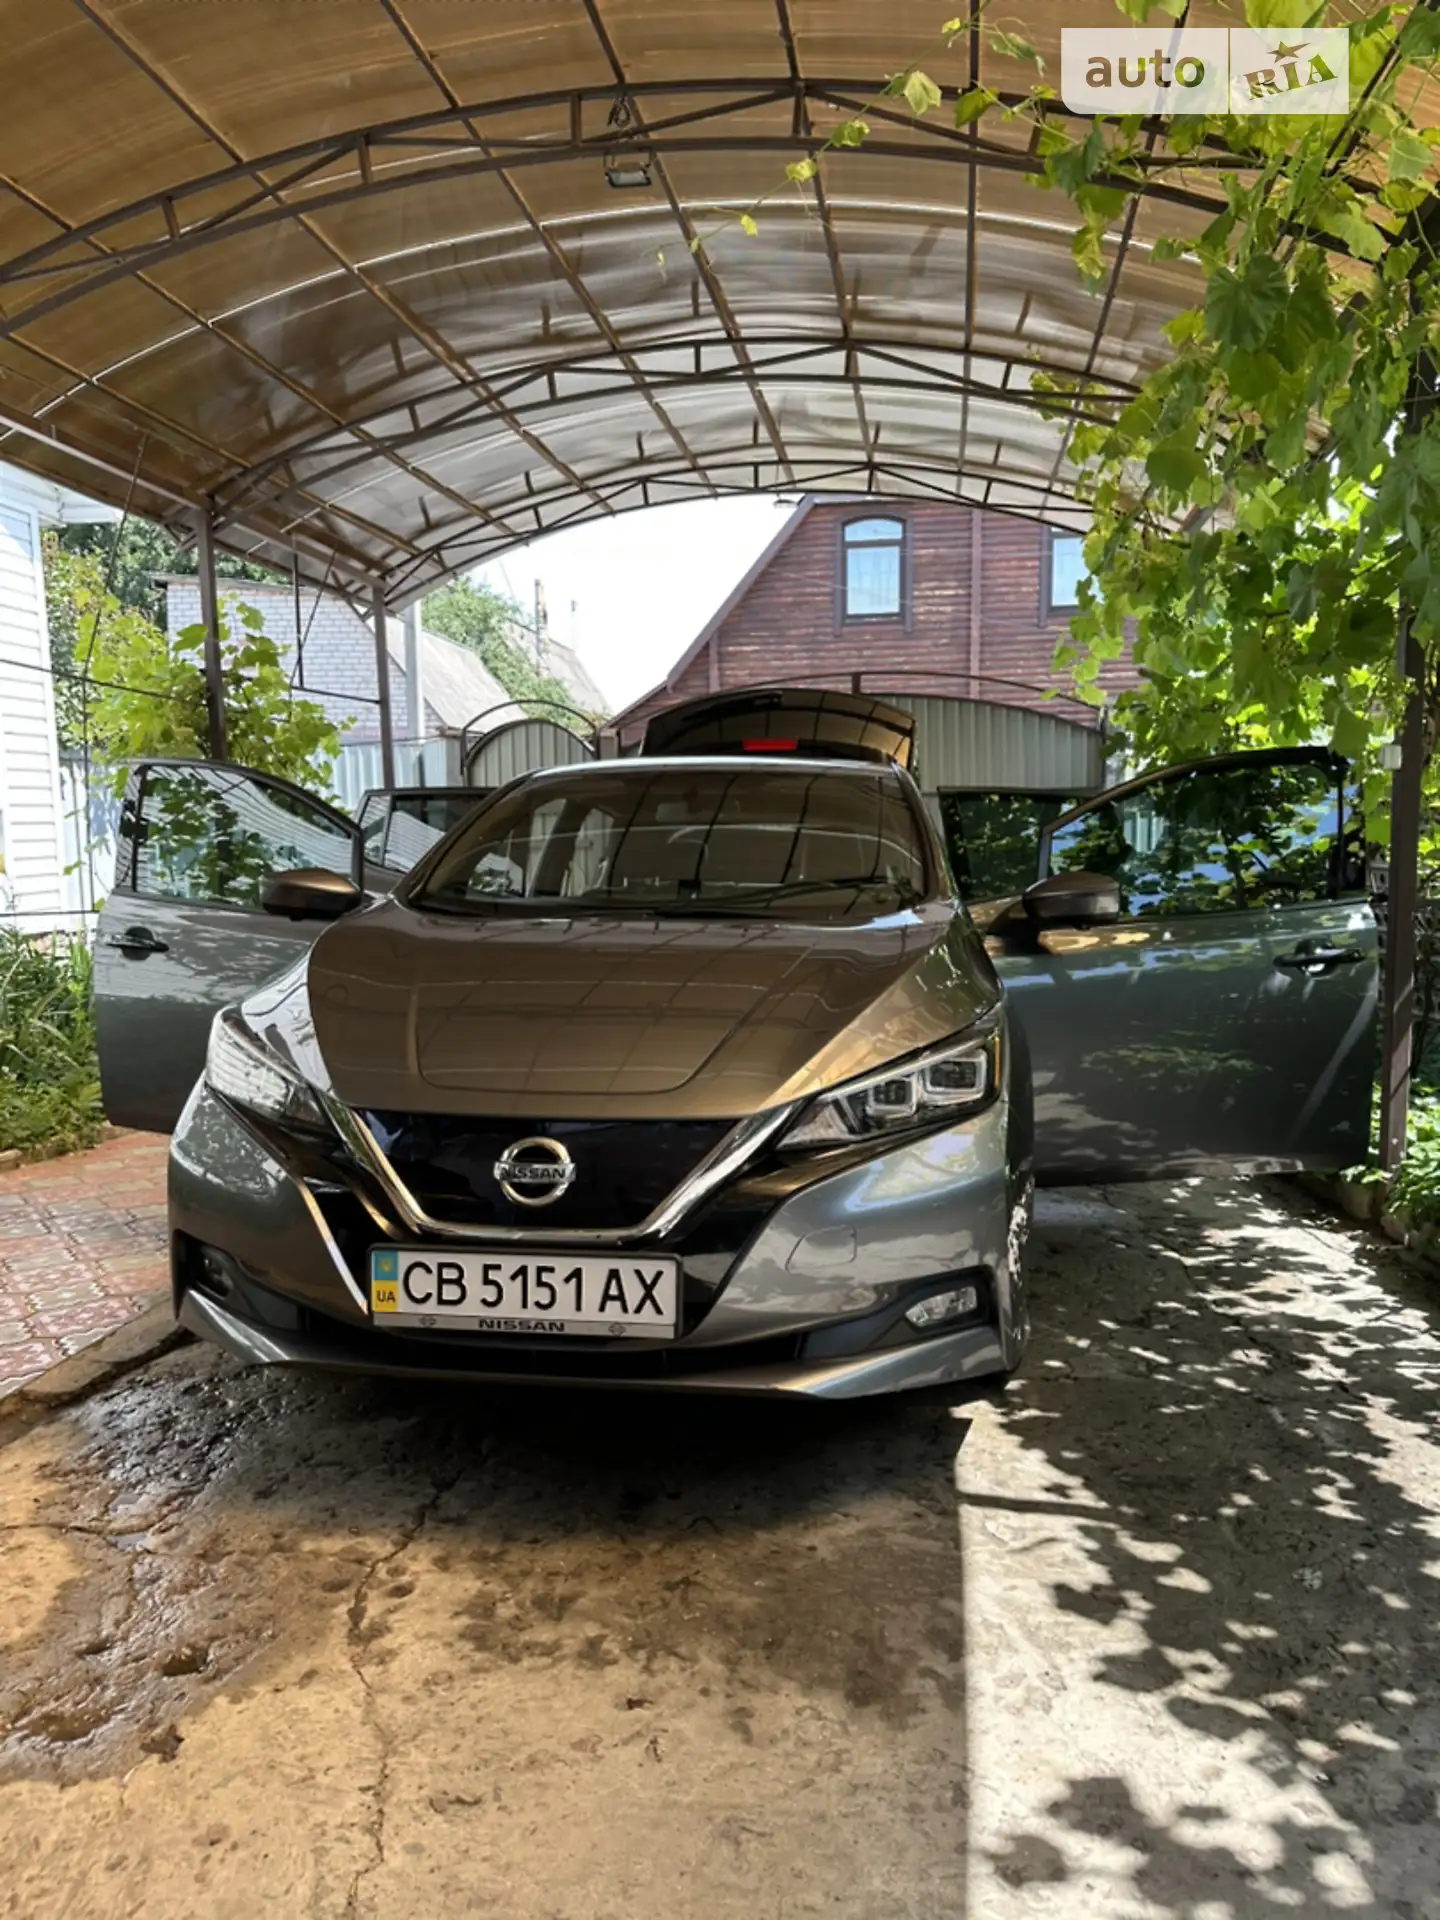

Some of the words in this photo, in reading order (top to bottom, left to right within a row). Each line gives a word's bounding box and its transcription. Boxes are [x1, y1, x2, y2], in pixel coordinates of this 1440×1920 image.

[500, 1166, 567, 1180] NISSAN
[402, 1261, 467, 1306] CB
[480, 1263, 583, 1313] 5151
[598, 1268, 664, 1316] AX
[376, 1290, 396, 1303] UA
[478, 1318, 565, 1333] NISSAN
